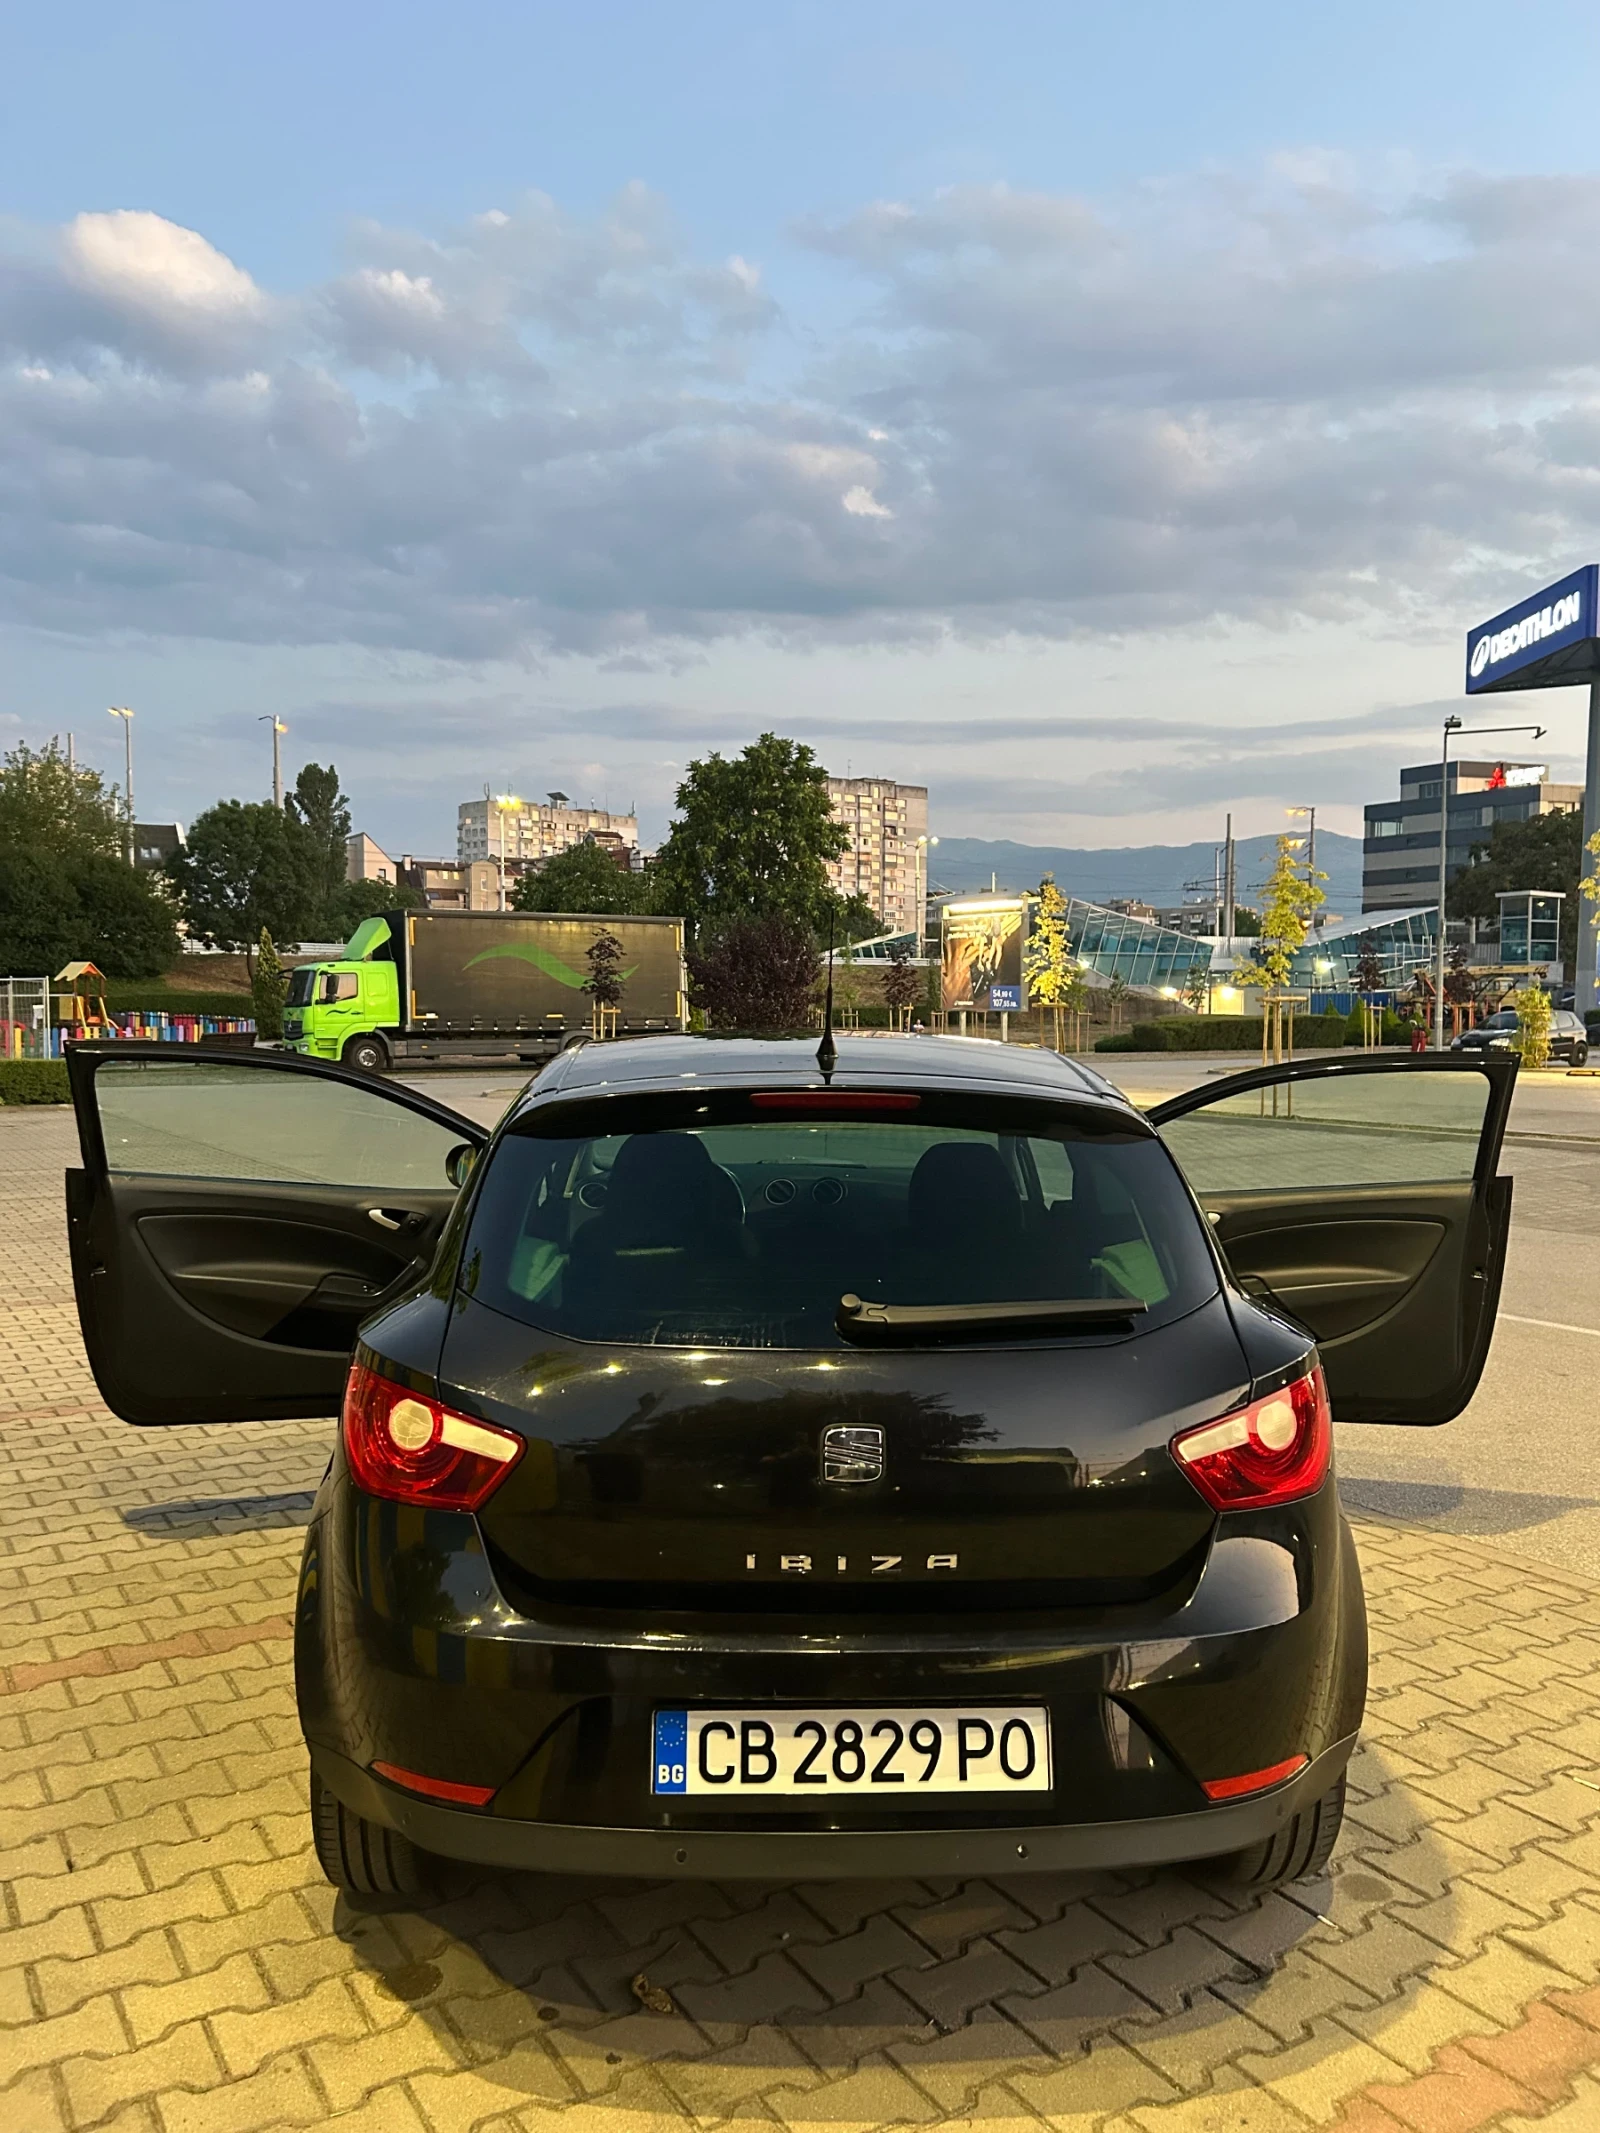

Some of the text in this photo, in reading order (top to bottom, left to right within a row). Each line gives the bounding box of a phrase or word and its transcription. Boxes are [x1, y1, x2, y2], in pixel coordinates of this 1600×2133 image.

[1489, 591, 1580, 664] DECATHLON
[746, 1554, 958, 1573] IBIZA
[699, 1720, 777, 1783] CB
[793, 1719, 942, 1783] 2829
[658, 1764, 684, 1784] BG
